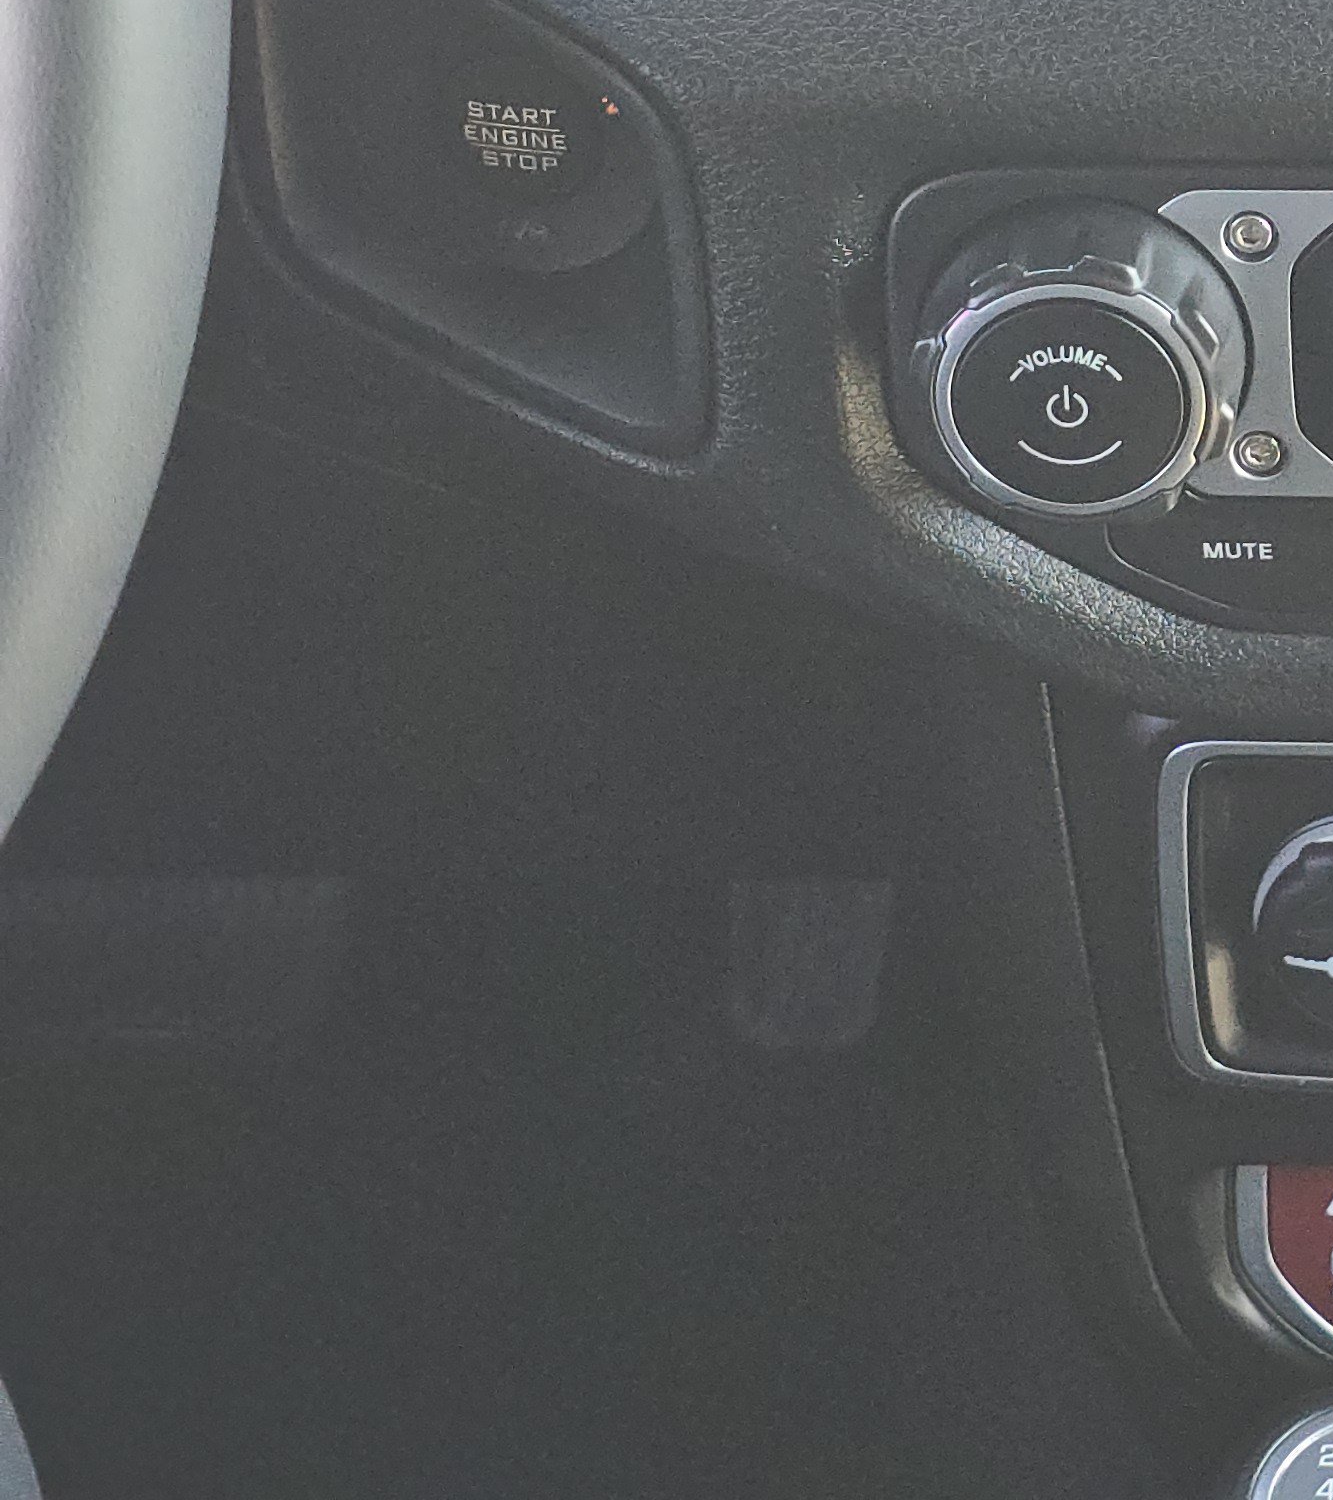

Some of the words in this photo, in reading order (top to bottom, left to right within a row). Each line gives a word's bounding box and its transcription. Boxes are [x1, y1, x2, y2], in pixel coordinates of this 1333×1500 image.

[469, 101, 555, 125] START
[465, 125, 566, 150] ENGINE
[483, 150, 557, 171] STOP
[1018, 348, 1108, 372] VOLUME
[1203, 543, 1273, 561] MUTE
